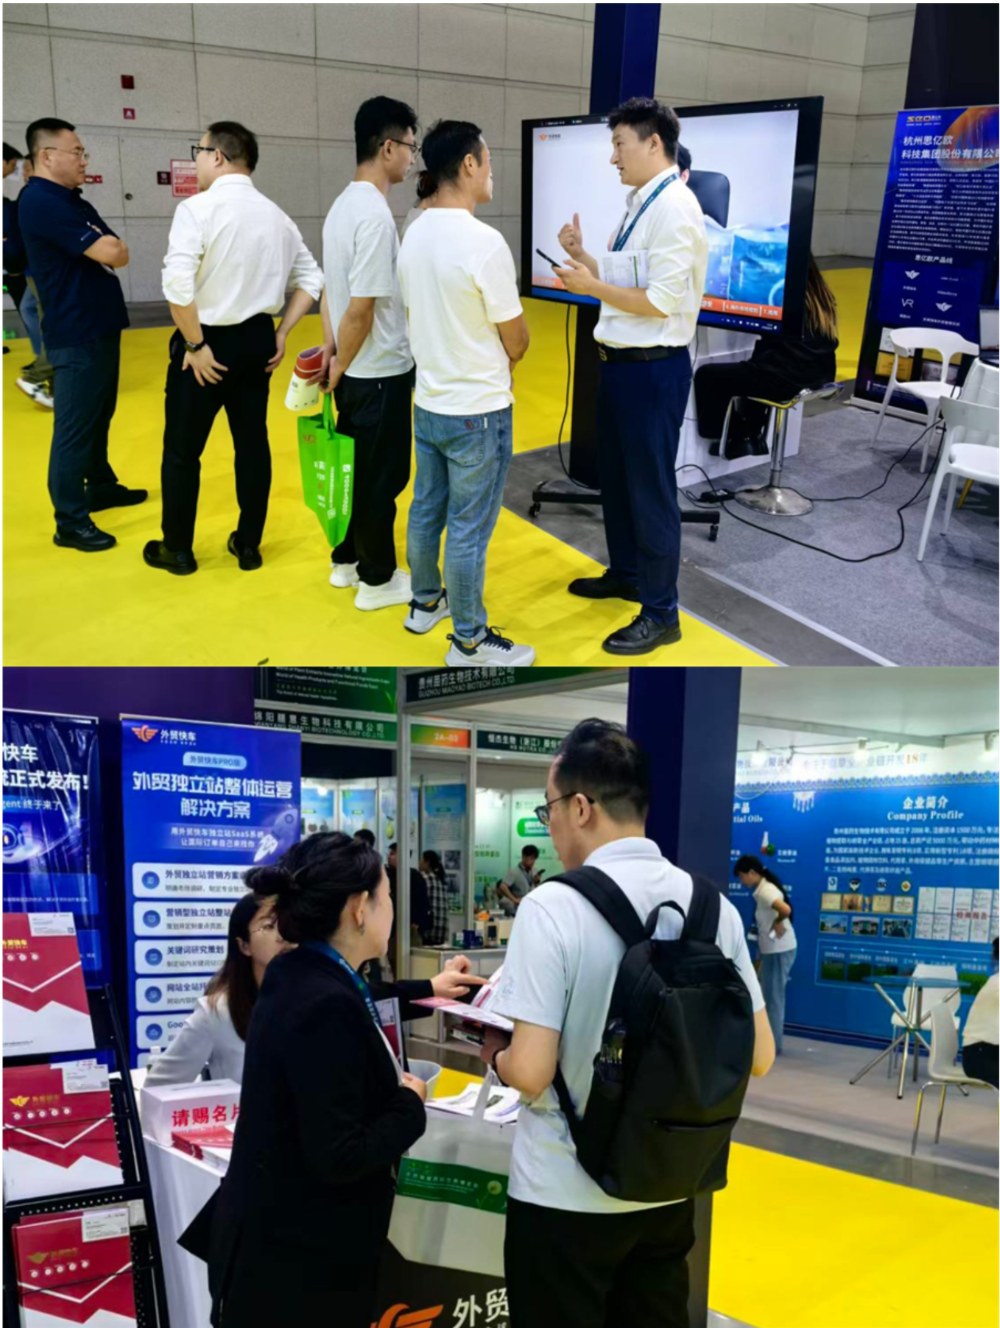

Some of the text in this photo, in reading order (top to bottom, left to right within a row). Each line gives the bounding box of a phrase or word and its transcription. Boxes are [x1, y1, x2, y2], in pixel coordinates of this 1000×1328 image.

[903, 135, 953, 146] 杭州思亿欧
[160, 730, 196, 741] 外贸快车
[3, 742, 38, 763] 快车
[132, 771, 293, 799] 外贸独立站整体运营
[181, 798, 250, 819] 解决方案
[902, 795, 949, 810] 企业简介
[887, 810, 965, 822] Company Profile
